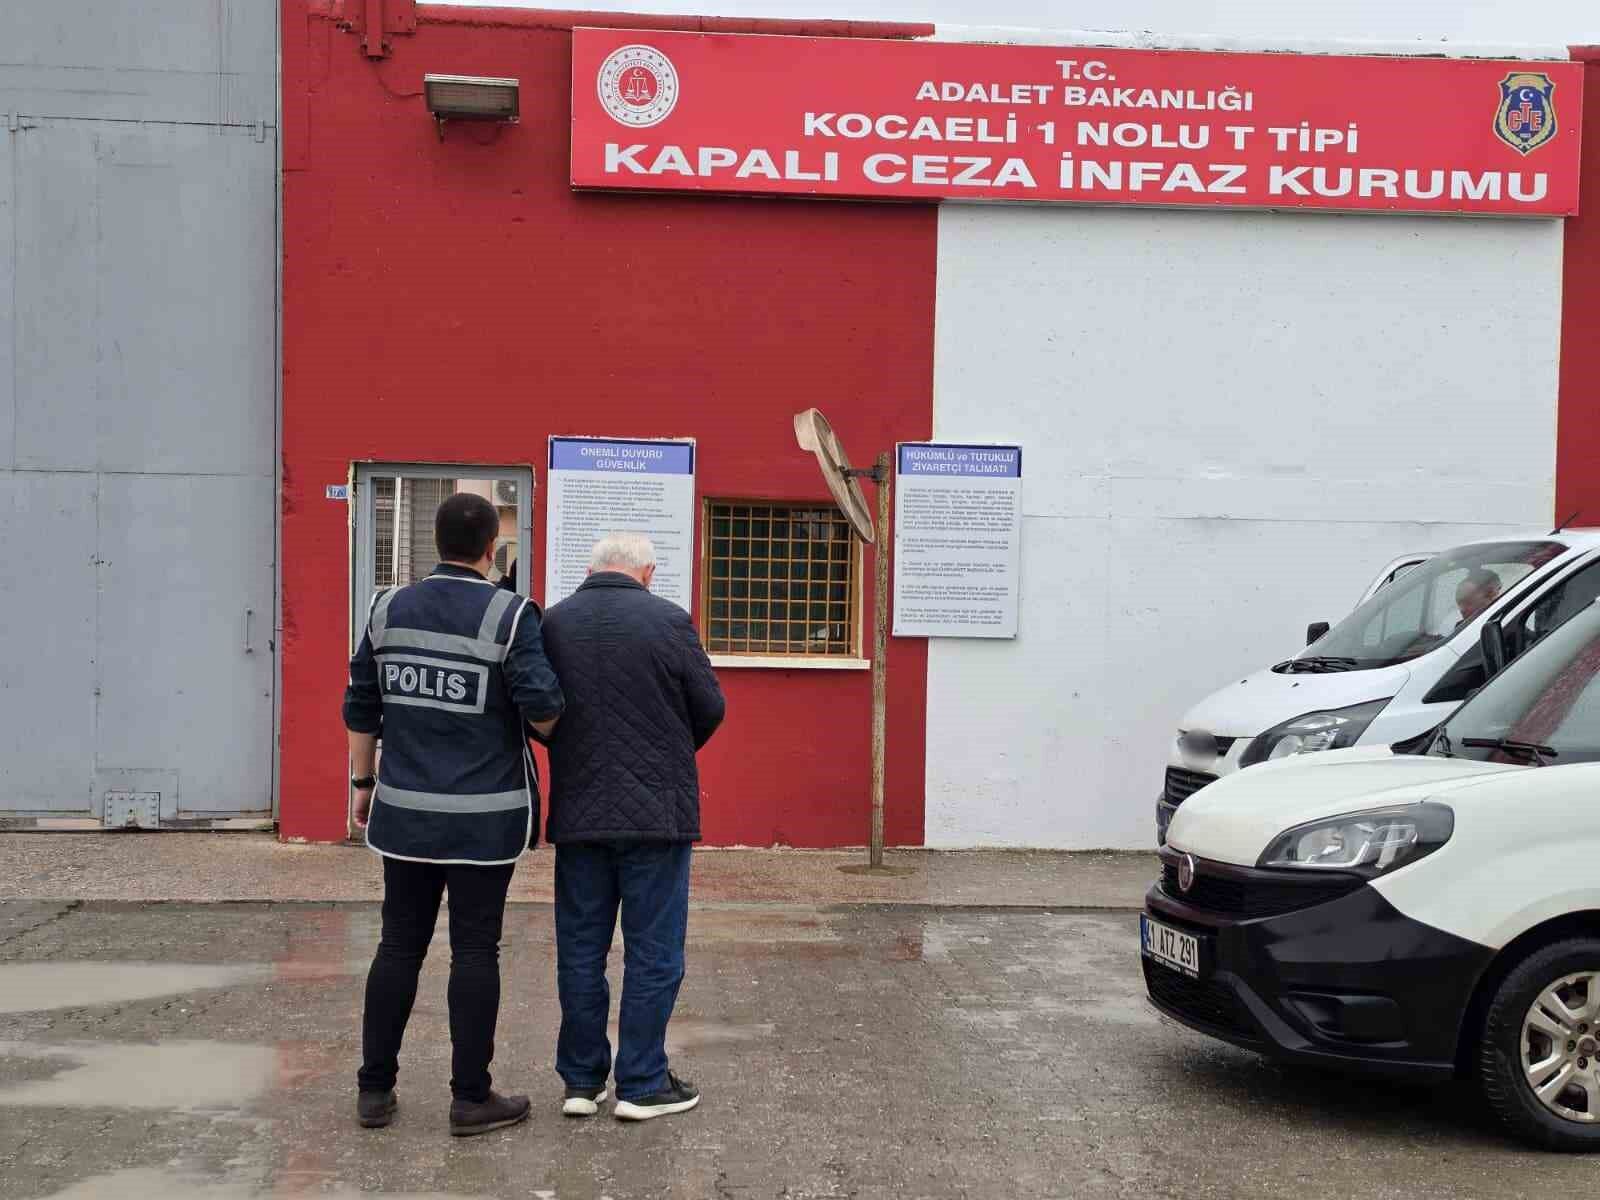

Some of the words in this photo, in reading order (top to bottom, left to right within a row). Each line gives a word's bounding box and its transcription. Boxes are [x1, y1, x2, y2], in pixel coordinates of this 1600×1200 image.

[1055, 60, 1116, 81] T.C.
[915, 80, 1054, 105] ADALET
[1064, 85, 1253, 112] BAKANLIĞI
[804, 111, 1018, 144] KOCAELİ
[1037, 121, 1055, 145] 1
[1077, 121, 1210, 150] NOLU
[1225, 125, 1255, 151] T
[1267, 121, 1358, 154] TİPİ
[604, 142, 839, 182] KAPALI
[862, 153, 1038, 188] CEZA
[1059, 151, 1247, 194] İNFAZ
[1269, 165, 1548, 203] KURUMU
[621, 448, 663, 459] DUYURU
[971, 451, 1014, 463] TUTUKLU
[1180, 935, 1198, 969] 291
